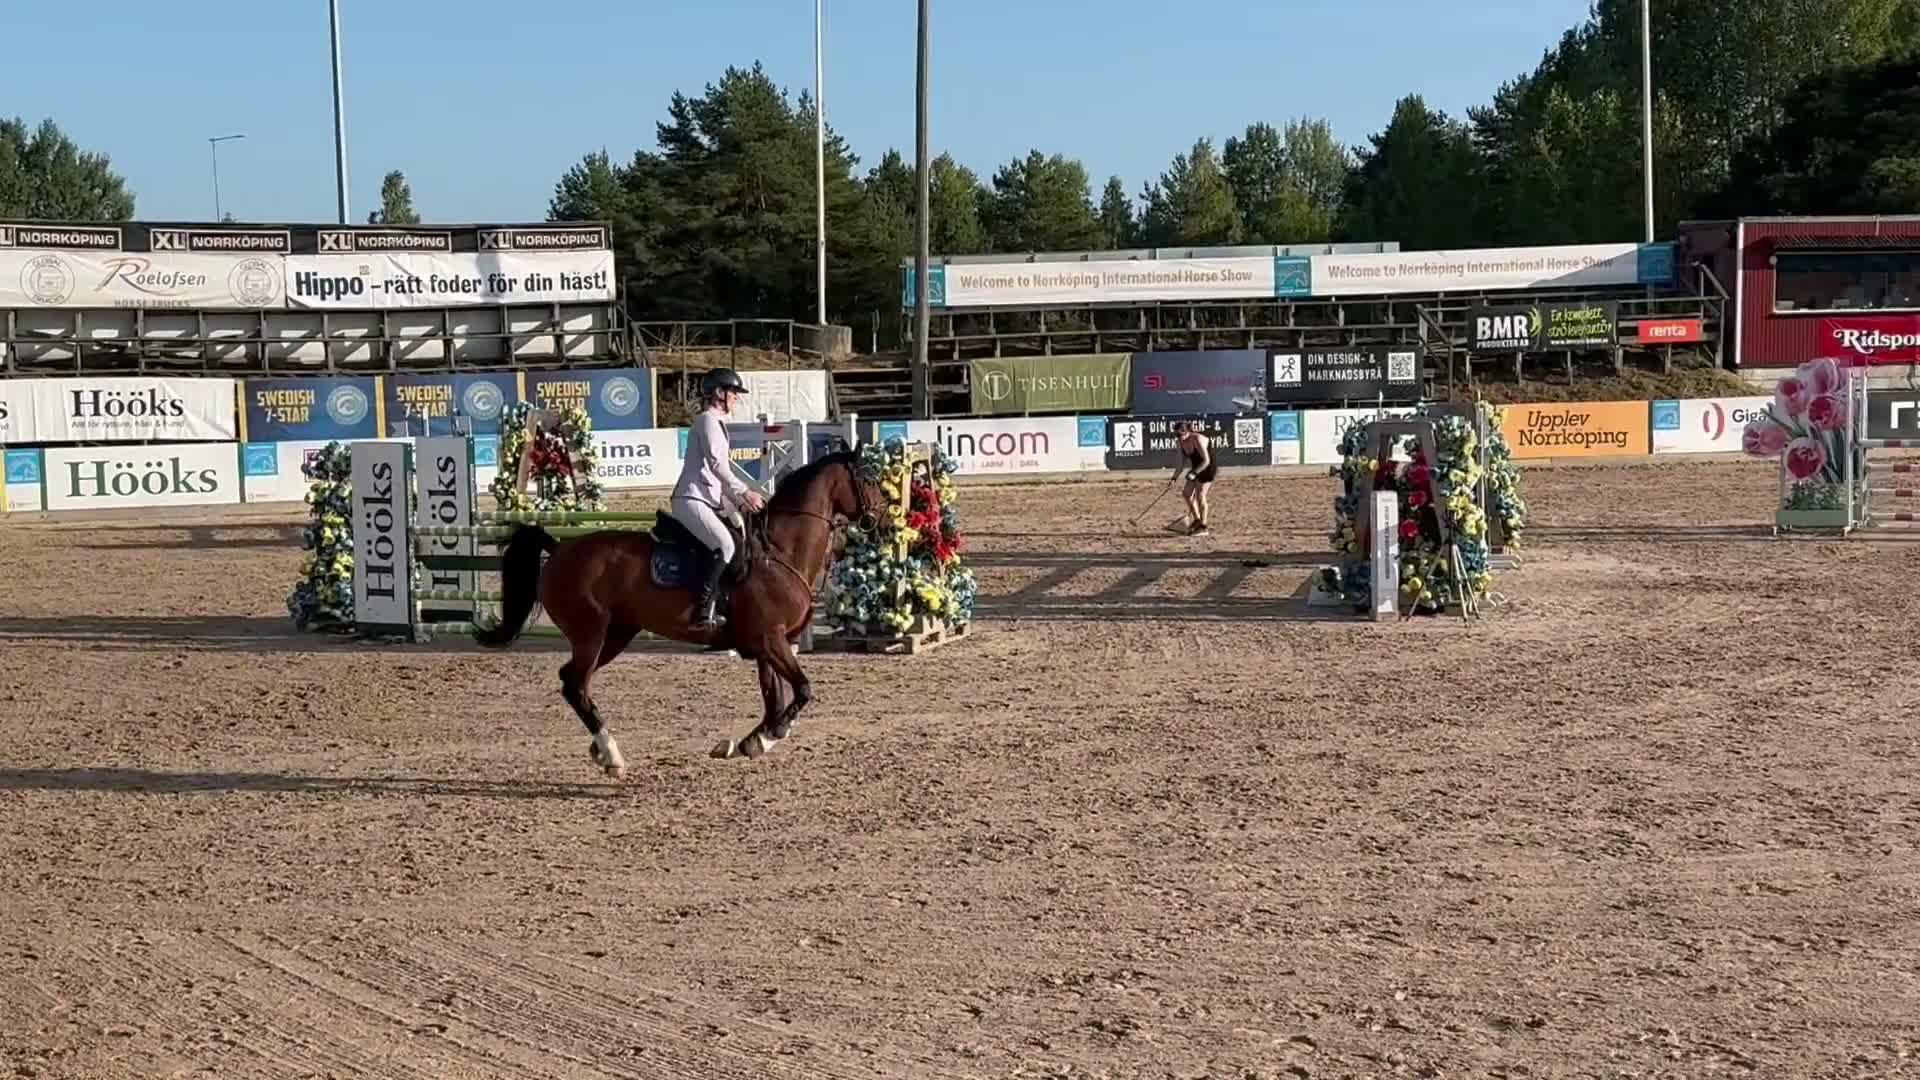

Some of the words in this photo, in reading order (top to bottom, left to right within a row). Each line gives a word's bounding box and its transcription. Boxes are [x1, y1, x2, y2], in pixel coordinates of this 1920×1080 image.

[20, 231, 115, 245] NORRKÖPING
[155, 231, 187, 249] XL
[193, 235, 285, 249] NORRKÖPING
[322, 233, 352, 250] XL
[358, 235, 446, 248] NORRKÖPING
[515, 234, 599, 247] NORRKÖPING
[94, 257, 207, 297] Roelofsen
[1328, 263, 1381, 279] Welcome
[1383, 264, 1397, 277] to
[1399, 261, 1465, 280] Norrköping
[1467, 258, 1545, 274] International
[1546, 257, 1580, 271] Horse
[1581, 256, 1616, 270] Show
[296, 272, 364, 301] Hippo
[429, 273, 482, 294] foder
[487, 272, 518, 293] för
[526, 272, 553, 292] din
[560, 270, 607, 291] häst!
[960, 273, 1015, 290] Welcome
[1017, 275, 1030, 287] to
[1033, 271, 1100, 290] Norrköping
[1103, 268, 1182, 286] International
[1184, 268, 1218, 283] Horse
[1220, 267, 1253, 282] Show
[1476, 314, 1529, 340] BMR
[1648, 324, 1687, 338] renta
[1308, 353, 1324, 365] DIN
[1369, 353, 1376, 363] &
[1017, 373, 1122, 392] TISENHULT
[1308, 366, 1382, 381] MARKNADSBYRÅ
[256, 389, 315, 407] SWEDISH
[396, 384, 453, 401] SWEDISH
[536, 380, 591, 398] SWEDISH
[70, 387, 185, 417] Hööks
[405, 402, 448, 418] 7-STAR
[264, 407, 310, 424] 7-STAR
[1526, 411, 1591, 432] Upplev
[1149, 420, 1166, 433] DIN
[1214, 420, 1222, 431] &
[1518, 428, 1628, 448] Norrköping
[601, 441, 651, 459] ima
[727, 447, 761, 461] WEDIS
[64, 456, 218, 498] Hööks
[596, 463, 652, 478] GBERGS
[362, 462, 396, 602] Hööks
